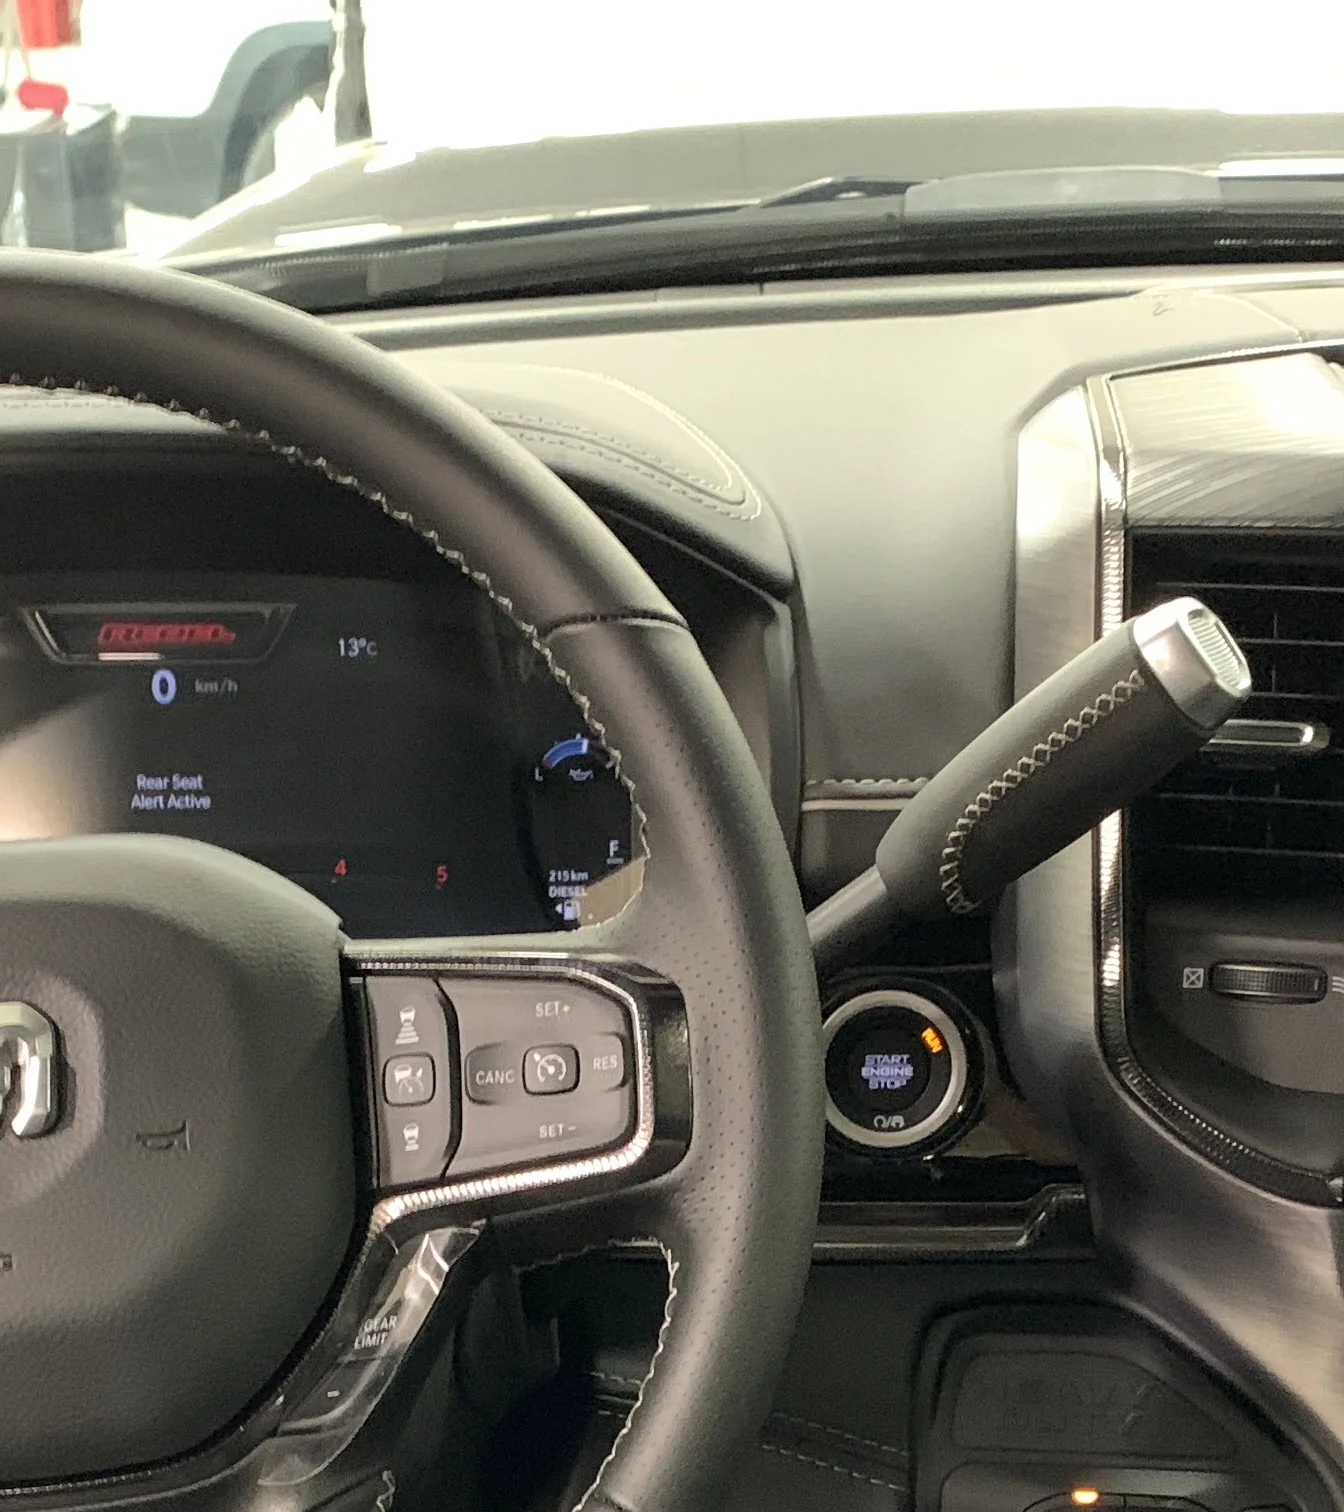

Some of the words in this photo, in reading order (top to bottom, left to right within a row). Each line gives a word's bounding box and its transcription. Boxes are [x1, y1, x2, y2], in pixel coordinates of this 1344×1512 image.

[151, 668, 177, 705] 0
[195, 679, 238, 694] km/h
[136, 774, 169, 791] Rear
[172, 773, 204, 791] Seat
[131, 793, 164, 810] Alert
[167, 793, 211, 810] Active
[608, 840, 619, 857] F
[333, 858, 347, 877] 4
[593, 1055, 618, 1071] RES
[865, 1054, 910, 1066] START
[475, 1070, 516, 1085] CANC
[861, 1066, 914, 1077] ENGINE
[869, 1077, 906, 1090] STOP
[364, 1316, 397, 1333] GEAR
[354, 1332, 388, 1349] LIMIT
